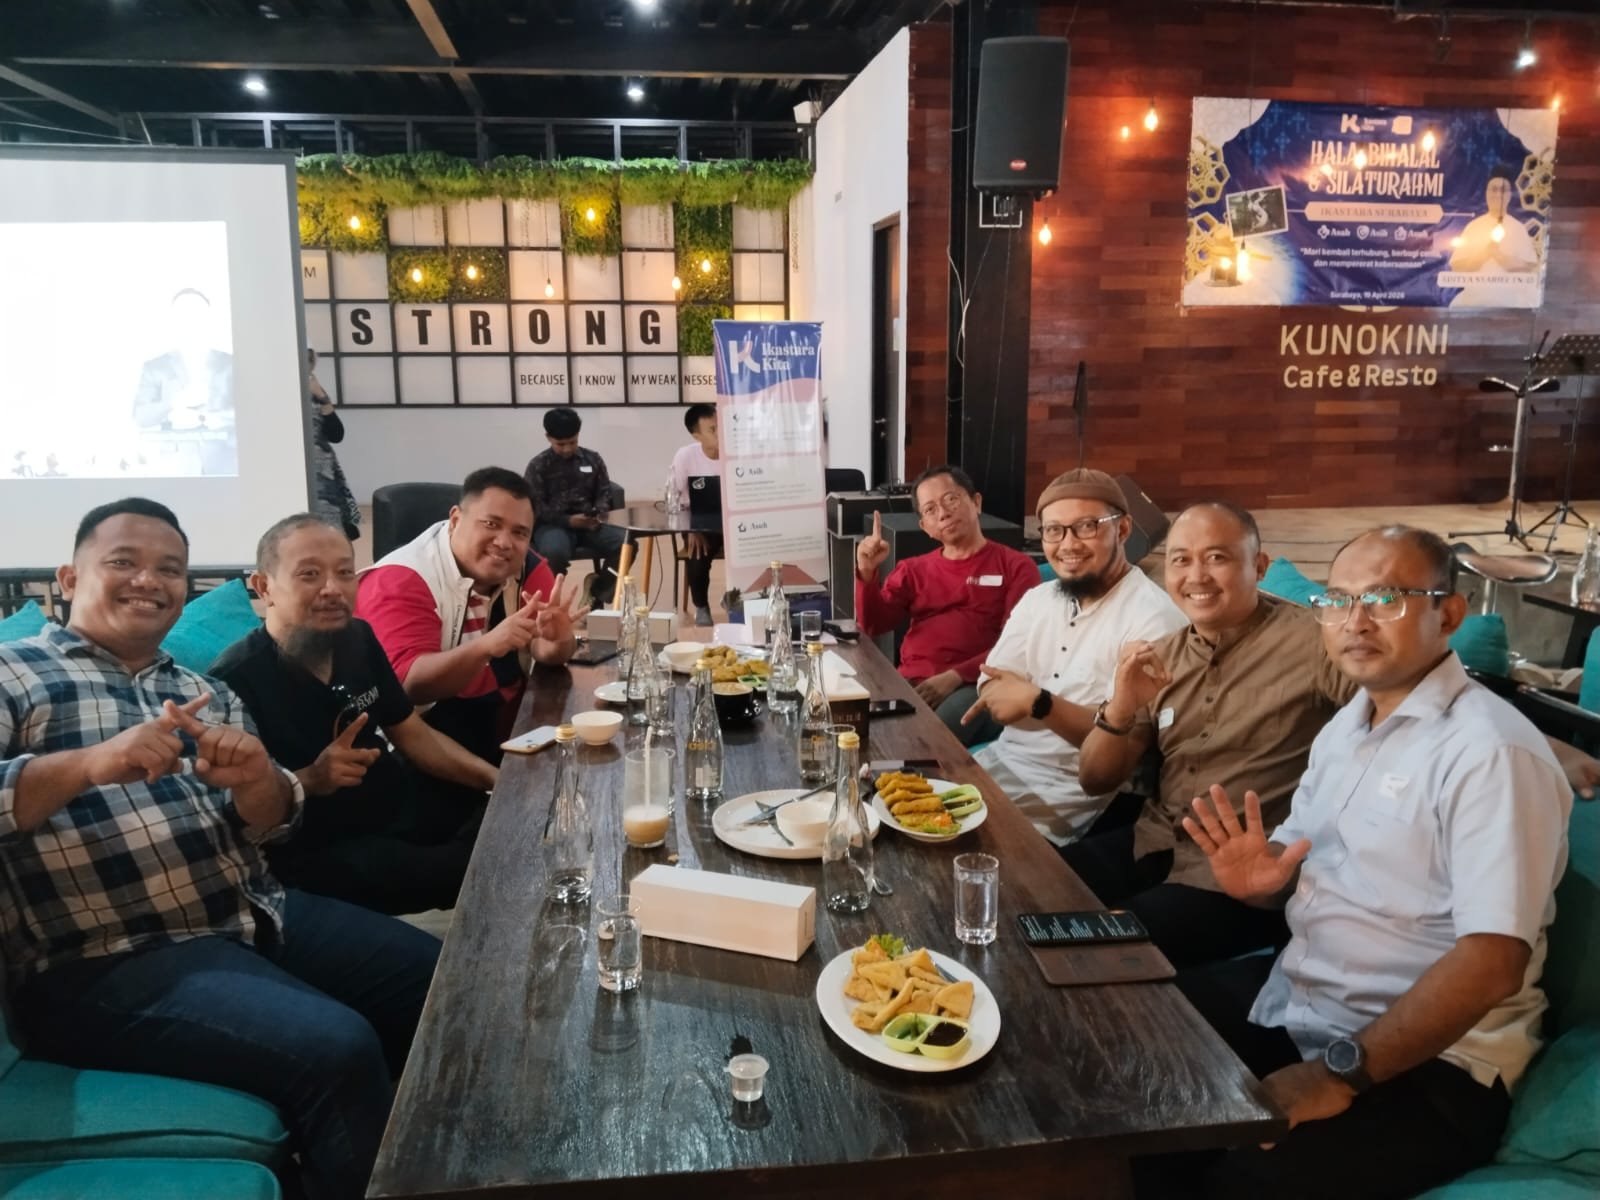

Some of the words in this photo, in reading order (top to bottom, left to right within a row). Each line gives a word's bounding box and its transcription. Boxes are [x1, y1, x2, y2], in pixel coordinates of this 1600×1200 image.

[1311, 140, 1366, 167] HALA
[1326, 170, 1444, 199] SILATURAHMI
[761, 341, 815, 357] Ikastara
[1279, 323, 1449, 356] KUNOKINI
[762, 357, 790, 371] Kita
[520, 374, 565, 386] BECAUSE
[585, 374, 616, 386] KNOW
[631, 374, 646, 385] MY
[649, 374, 677, 386] WEAK
